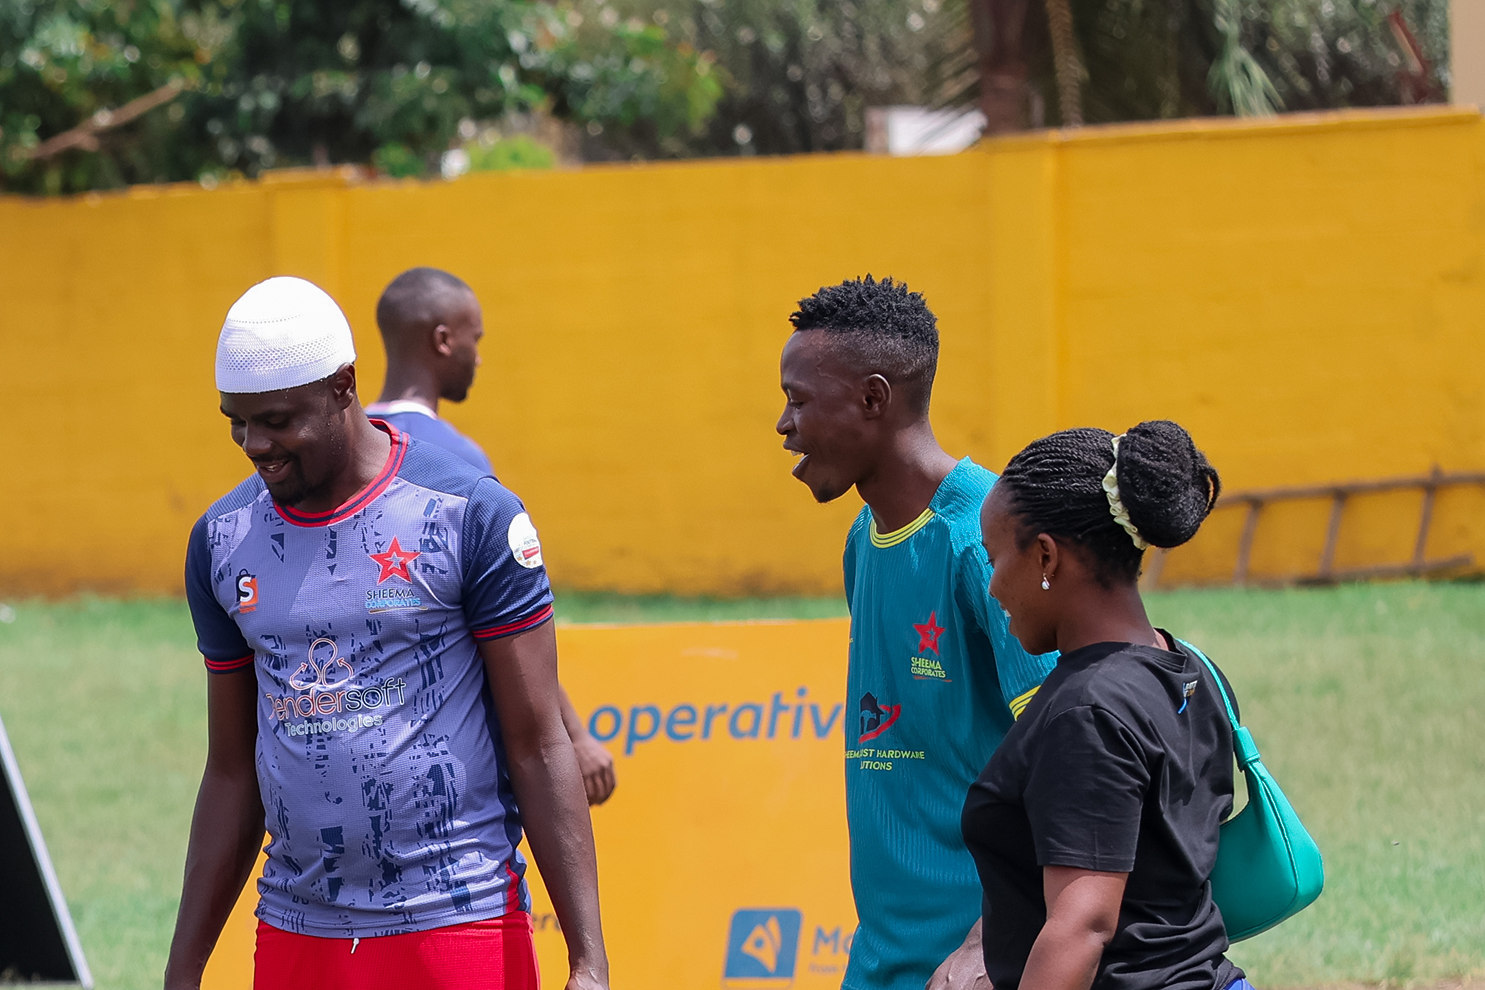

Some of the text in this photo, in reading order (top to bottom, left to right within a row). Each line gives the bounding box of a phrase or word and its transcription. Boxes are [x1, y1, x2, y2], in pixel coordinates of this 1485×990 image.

[366, 588, 415, 600] SHEEMA
[910, 656, 943, 671] SHEEMA
[285, 713, 384, 736] Technologies
[588, 685, 846, 757] operativ
[876, 749, 925, 760] HARDWARE
